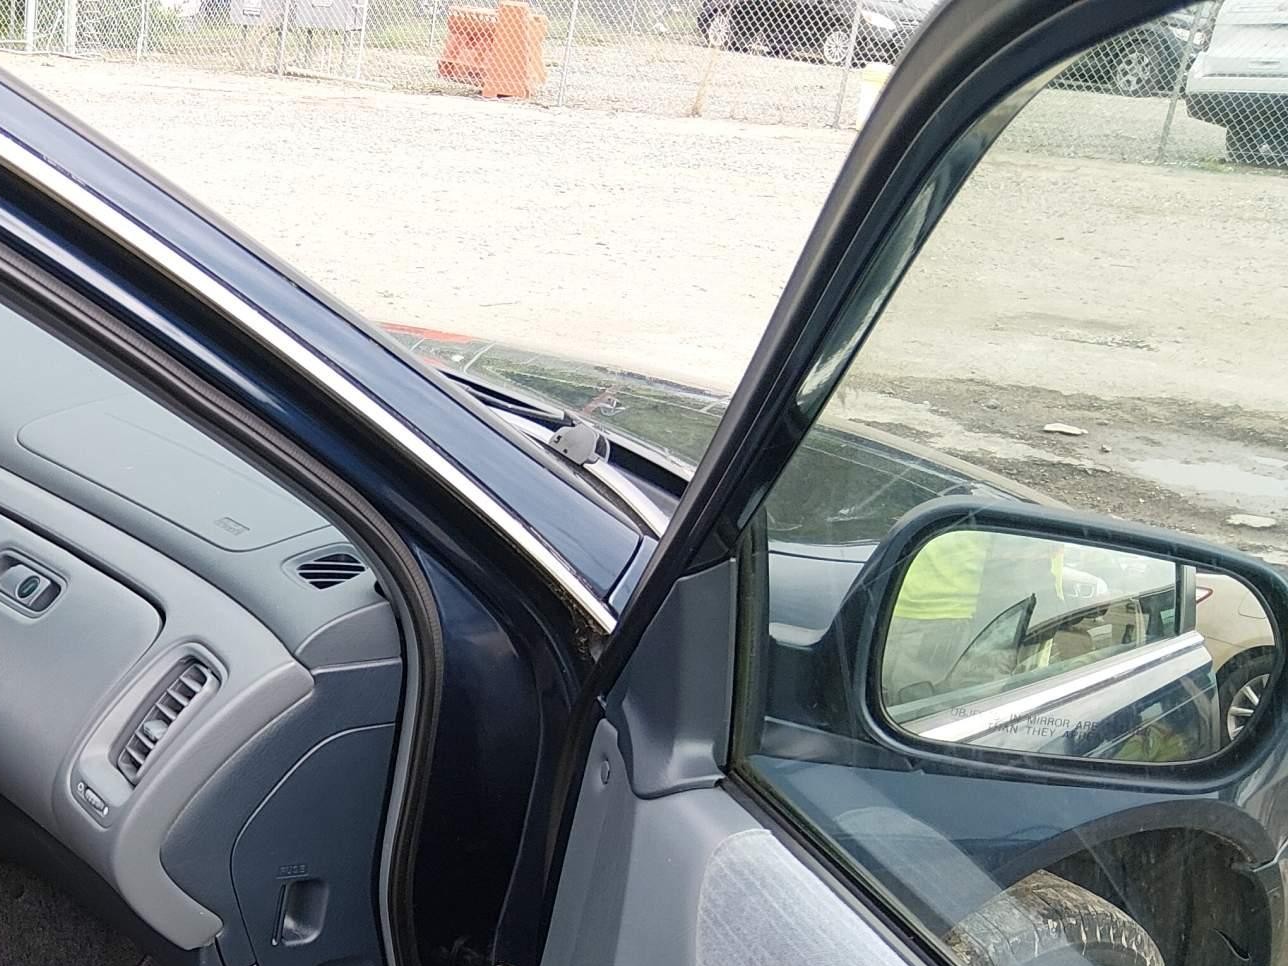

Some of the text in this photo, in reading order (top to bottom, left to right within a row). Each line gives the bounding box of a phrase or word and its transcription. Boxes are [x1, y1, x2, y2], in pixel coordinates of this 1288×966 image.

[1027, 714, 1070, 730] MIRROR
[1074, 719, 1099, 733] ARE
[1025, 726, 1056, 737] THEY
